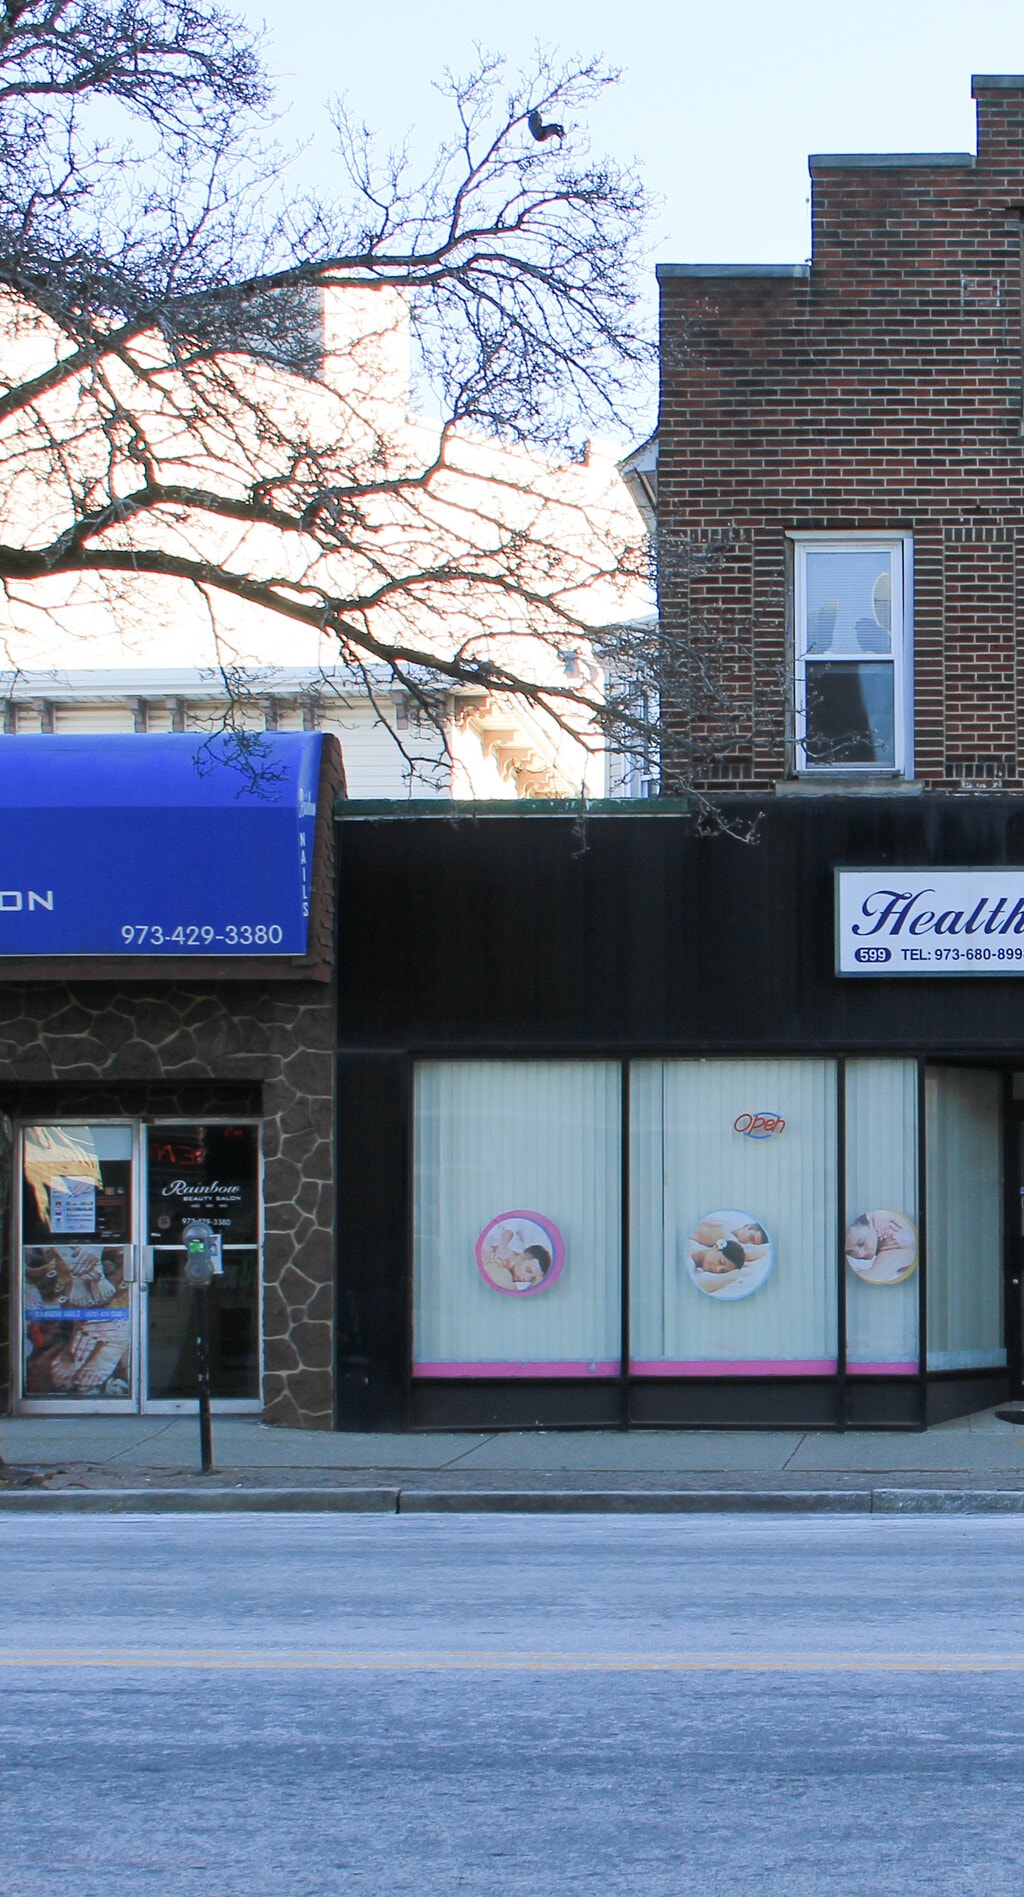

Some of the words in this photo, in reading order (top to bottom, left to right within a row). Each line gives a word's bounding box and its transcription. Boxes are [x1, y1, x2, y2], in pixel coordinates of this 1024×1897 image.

[299, 832, 309, 917] NAILS
[121, 925, 283, 945] 973-429-3380
[860, 949, 886, 962] 599
[900, 948, 931, 961] TEL:
[734, 1113, 786, 1135] Open
[162, 1180, 240, 1196] Rainbow
